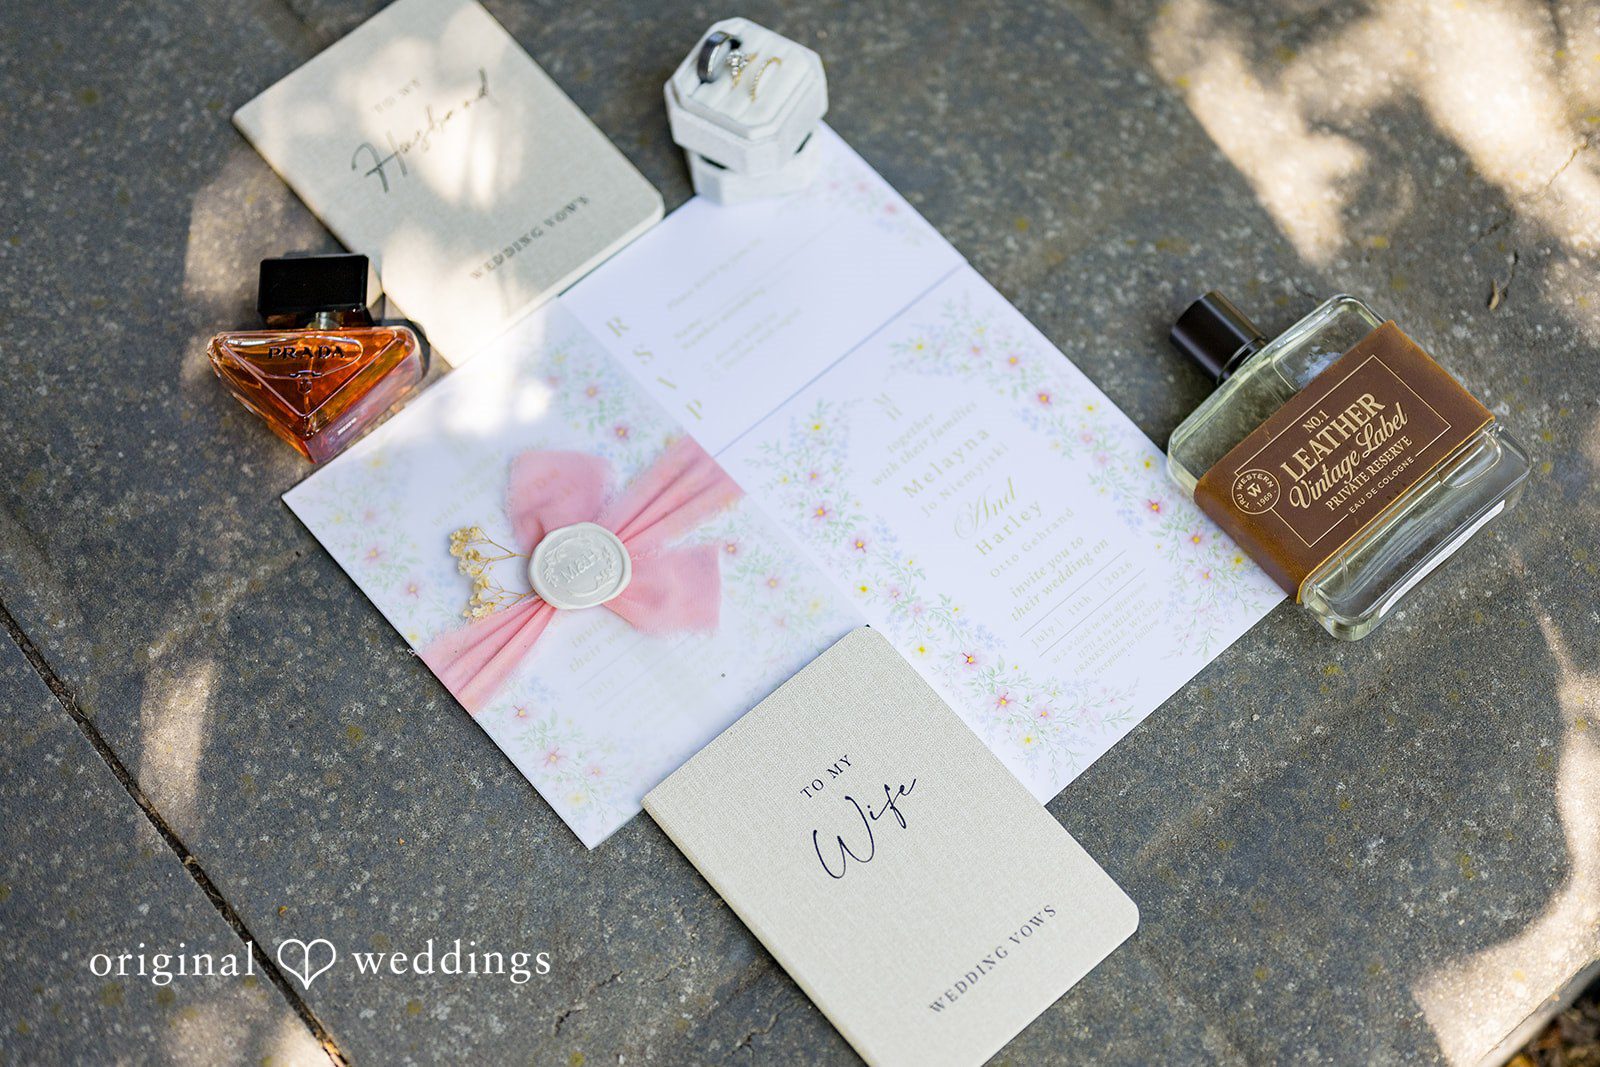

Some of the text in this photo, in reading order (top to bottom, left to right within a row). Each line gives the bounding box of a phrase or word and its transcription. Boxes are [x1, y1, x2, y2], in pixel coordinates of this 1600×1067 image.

[469, 194, 591, 281] WEDDING VOWS
[268, 345, 345, 360] PRADA
[1280, 392, 1386, 483] LEATHER
[1302, 409, 1330, 434] NO.1
[872, 461, 900, 486] with
[900, 437, 929, 464] their
[902, 429, 989, 498] Melayna
[1289, 402, 1409, 510] Vintage Label
[1325, 435, 1413, 512] PRIVATE RESERVE
[1348, 456, 1415, 515] EAU DE COLOGNE
[954, 475, 1017, 540] And
[1236, 473, 1275, 509] TRU WESTERN
[1256, 491, 1273, 508] 1969
[975, 500, 1042, 556] Harley
[990, 553, 1020, 578] Otto
[1010, 535, 1084, 599] invite you to
[1011, 540, 1109, 622] their wedding on
[800, 754, 852, 800] TO MY
[812, 778, 917, 879] Wife
[928, 904, 1057, 1014] WEDDING VOWS
